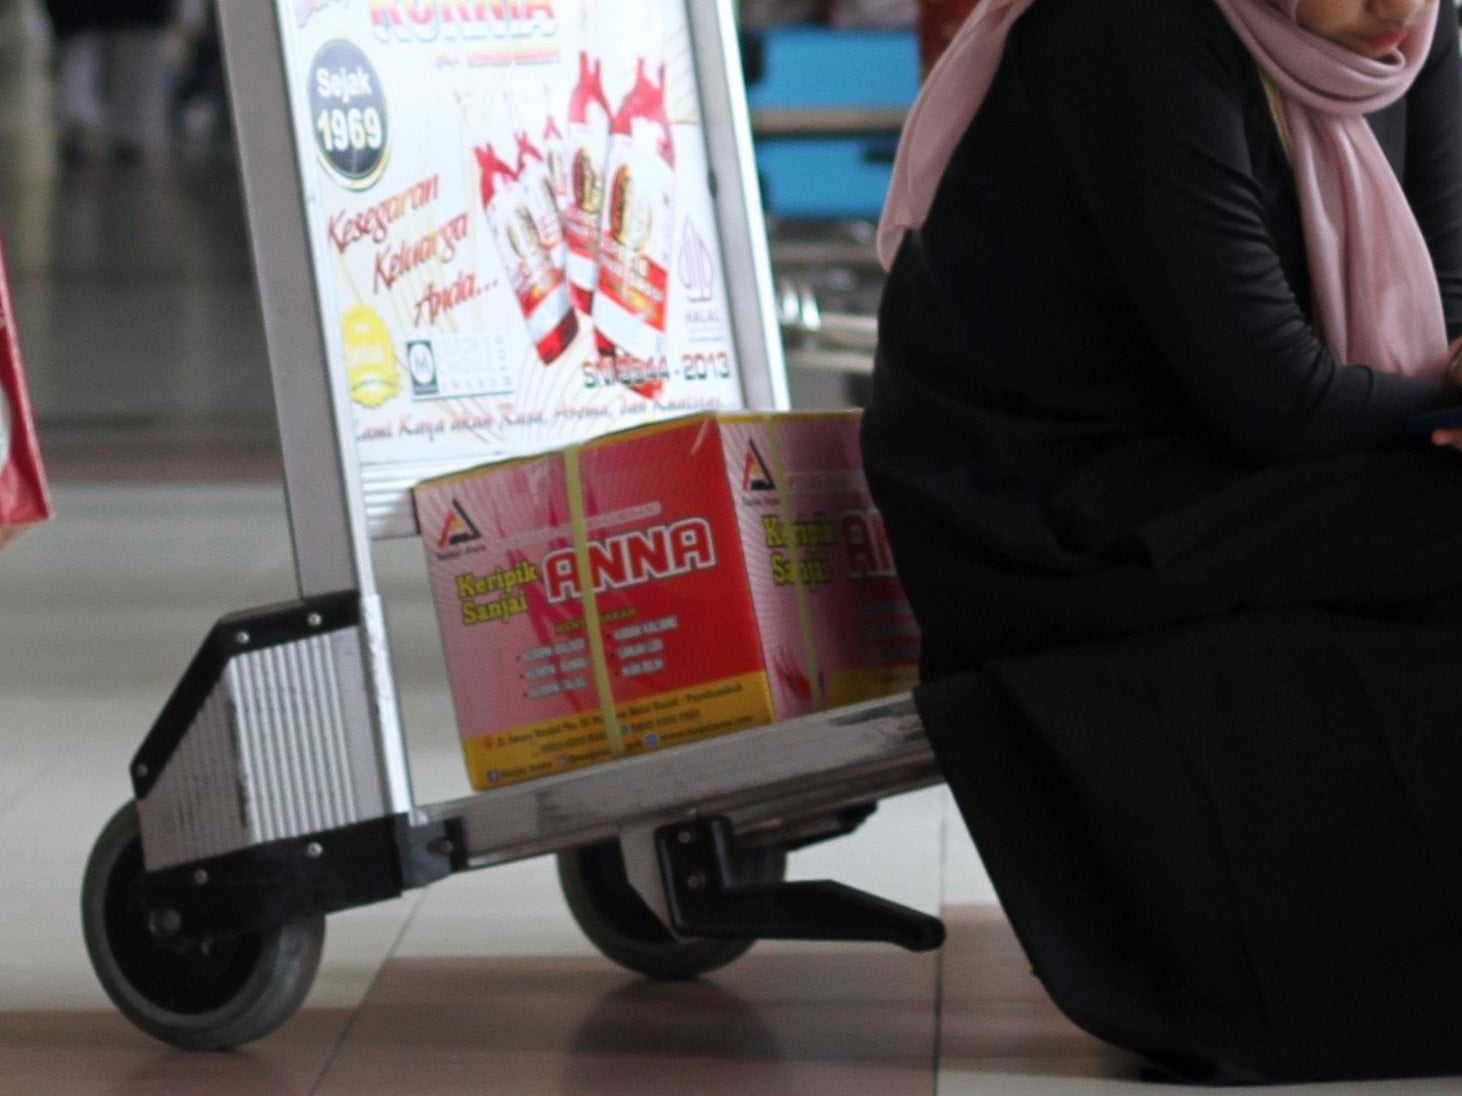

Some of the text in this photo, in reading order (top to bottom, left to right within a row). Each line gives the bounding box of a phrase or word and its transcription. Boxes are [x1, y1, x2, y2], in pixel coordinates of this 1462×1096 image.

[316, 66, 373, 103] Sejak
[317, 106, 382, 151] 1969
[328, 173, 439, 254] Kesegaran
[372, 211, 470, 295] Keluarga
[683, 351, 730, 380] 2013
[456, 558, 539, 599] Keripik
[542, 516, 718, 604] ANNA
[462, 590, 529, 627] Sanjai
